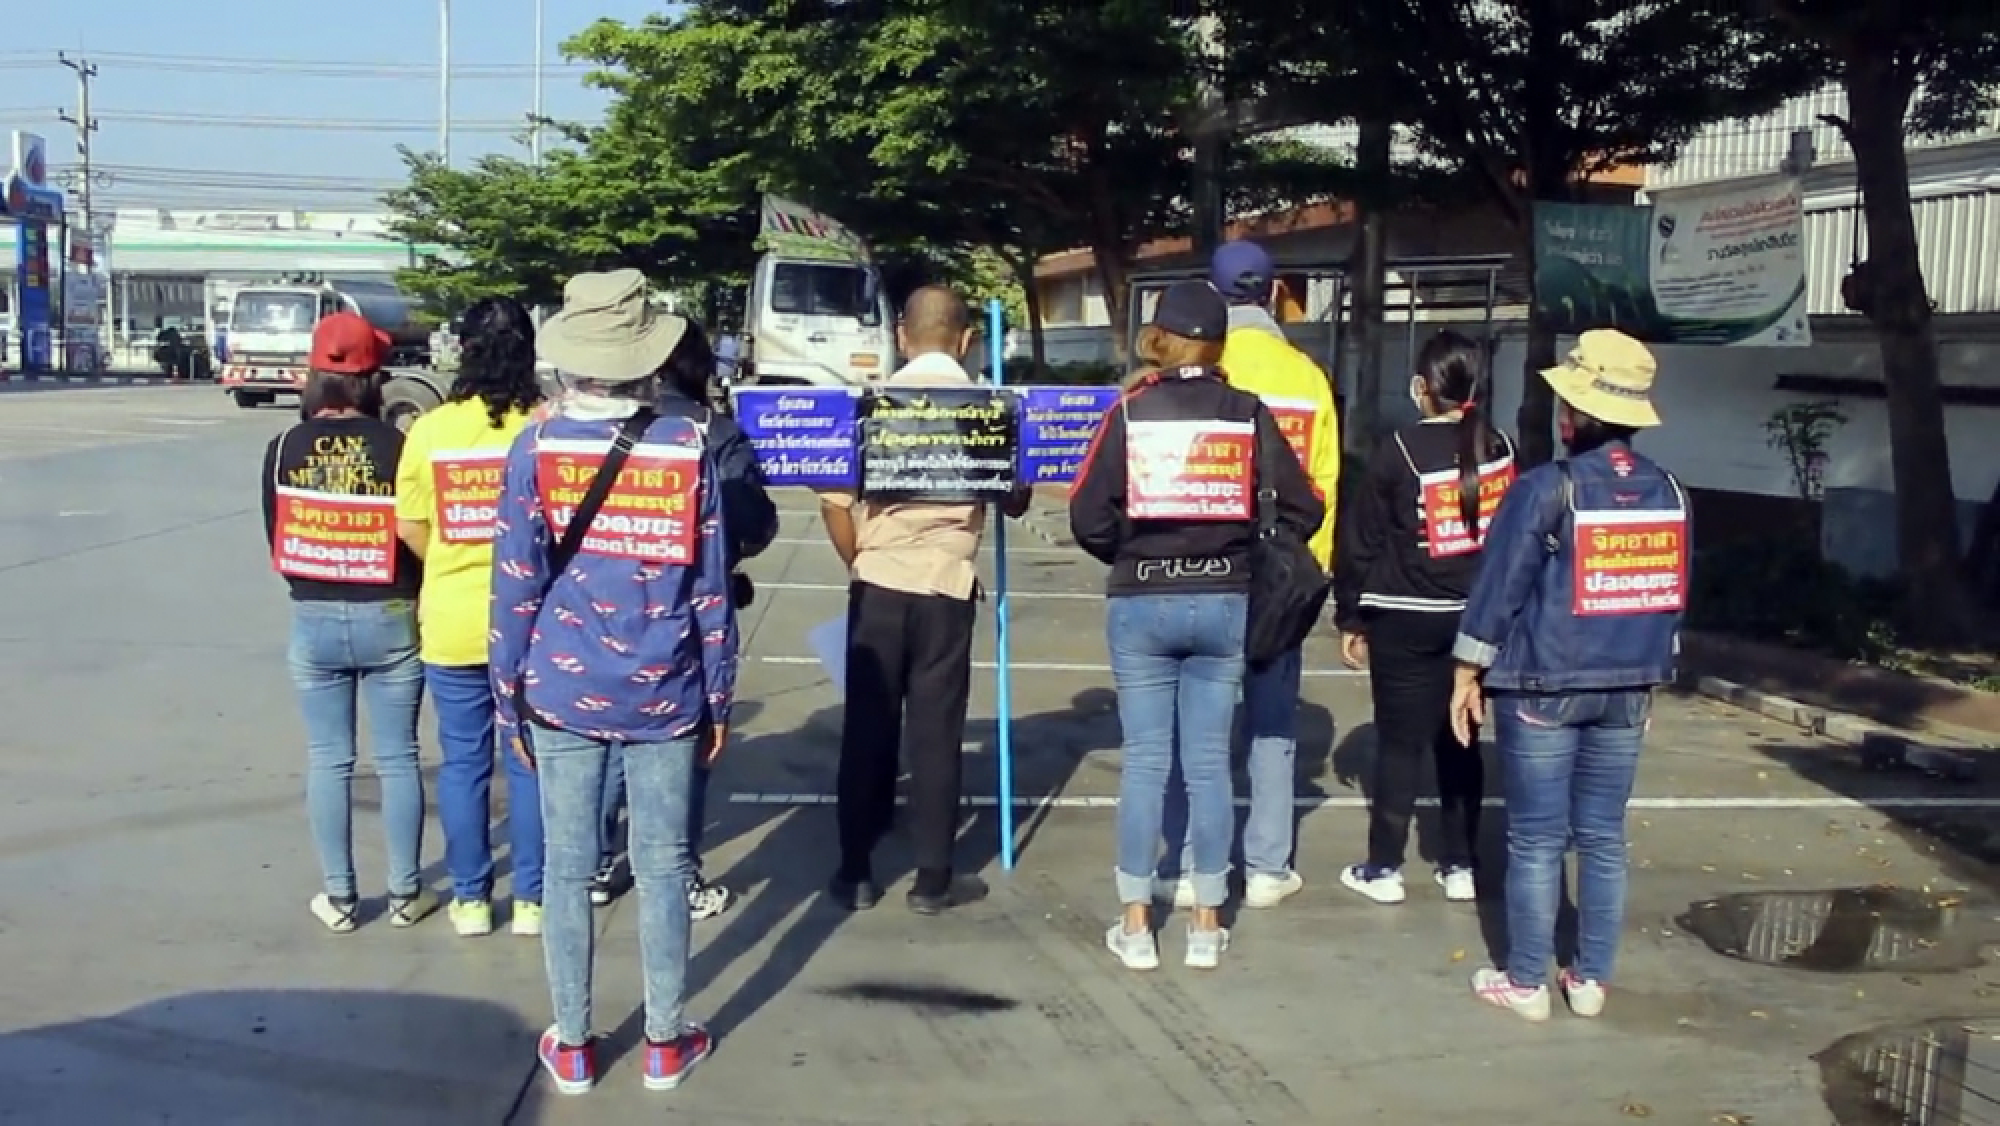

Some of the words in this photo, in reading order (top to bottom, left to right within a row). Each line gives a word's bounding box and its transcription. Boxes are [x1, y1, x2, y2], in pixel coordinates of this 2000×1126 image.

[314, 436, 364, 454] CAN
[555, 457, 682, 489] จิตาสา
[289, 499, 385, 527] จิตอาสา
[550, 506, 683, 536] ปอดขยะ
[283, 537, 387, 563] ปลอดขยะ
[1591, 528, 1678, 551] จิตอาสา
[1584, 571, 1679, 593] ปลอดขยะ
